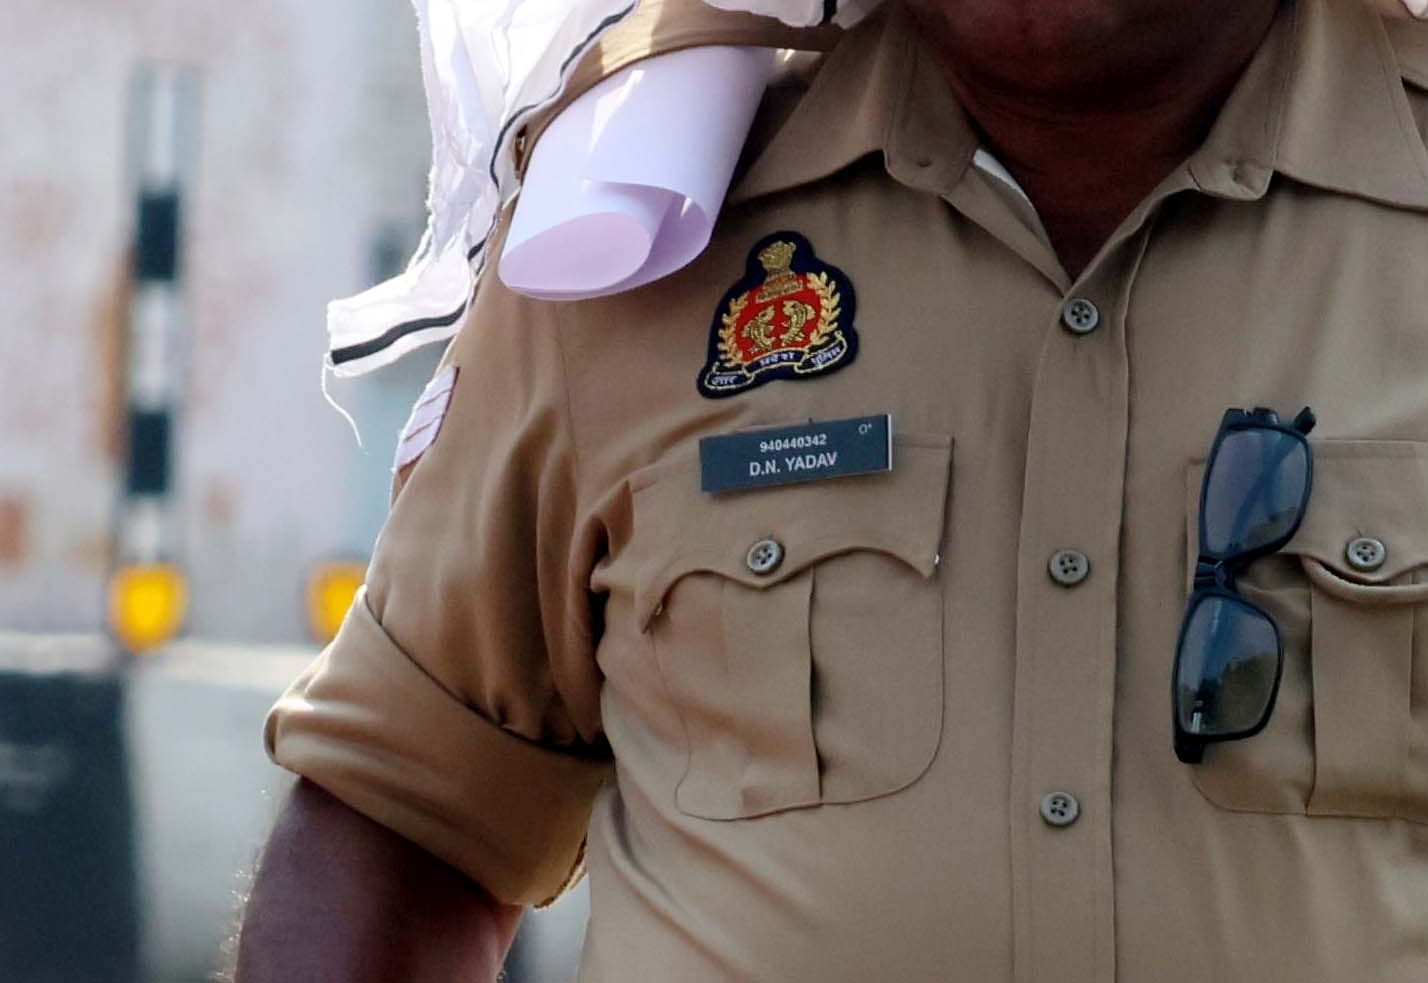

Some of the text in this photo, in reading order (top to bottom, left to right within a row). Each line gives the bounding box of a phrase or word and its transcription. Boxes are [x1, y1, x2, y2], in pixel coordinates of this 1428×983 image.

[759, 434, 827, 453] 940440342
[749, 451, 838, 476] D.N. YADAV
